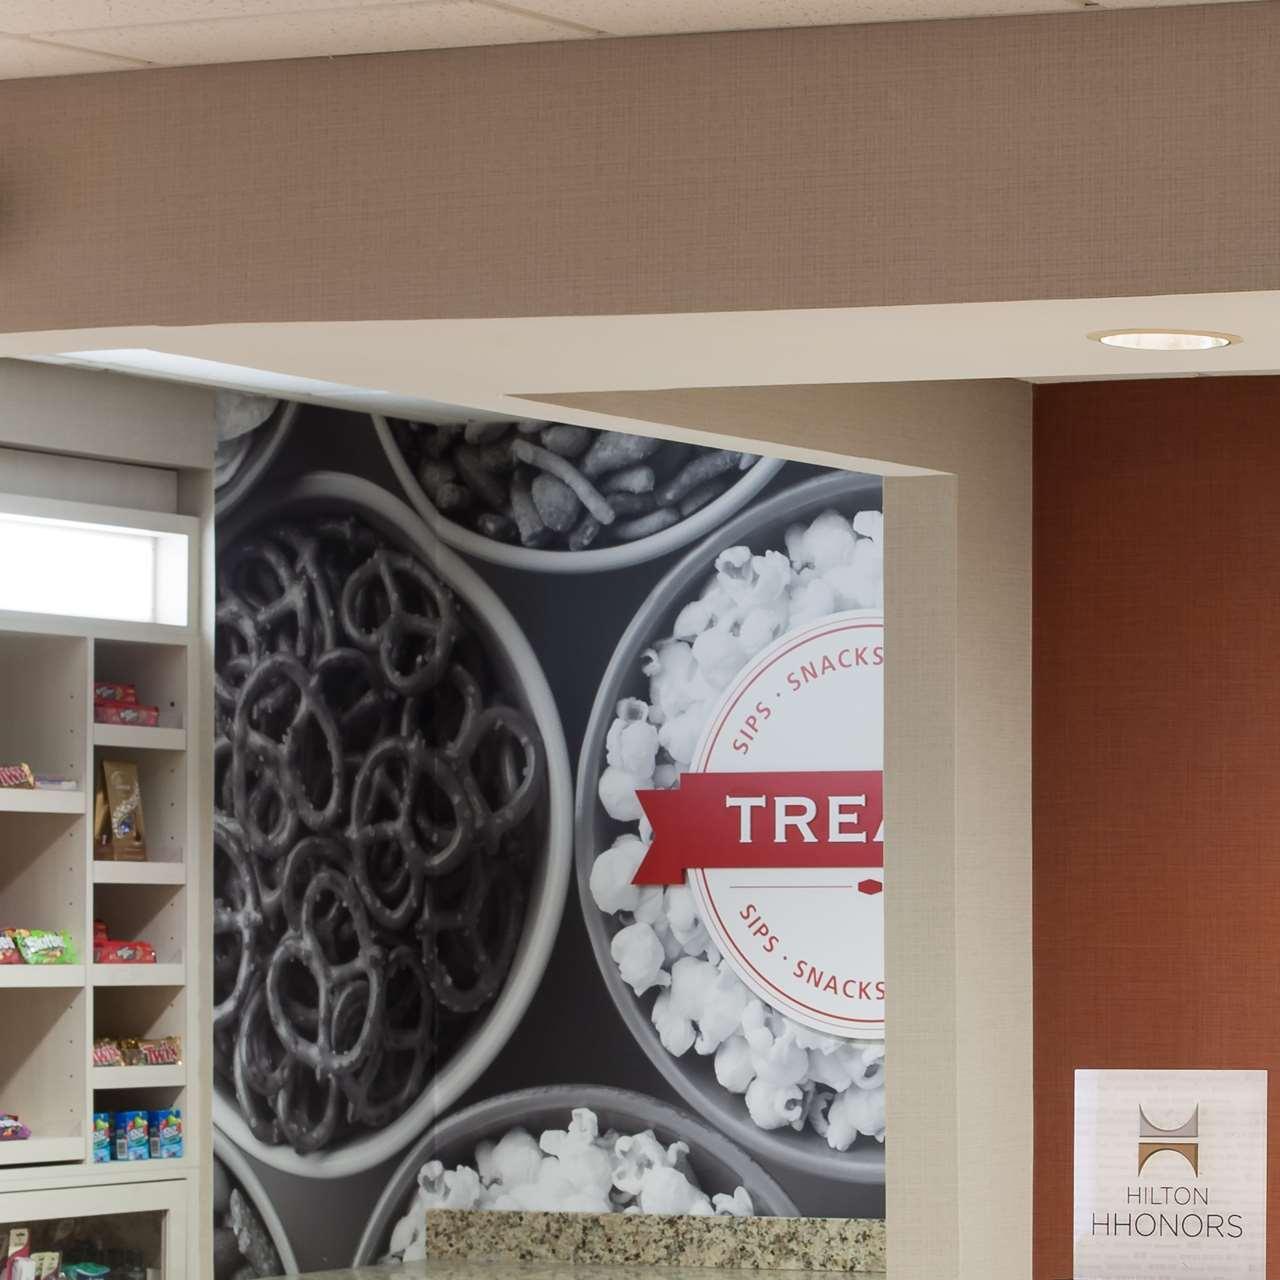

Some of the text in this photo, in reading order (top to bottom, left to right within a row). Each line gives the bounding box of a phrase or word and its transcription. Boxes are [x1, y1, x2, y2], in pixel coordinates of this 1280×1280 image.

[732, 701, 771, 755] SIPS
[726, 794, 884, 843] TRE
[740, 904, 779, 952] SIPS
[1127, 1186, 1208, 1205] HILTON
[1092, 1212, 1243, 1238] HHONORS
